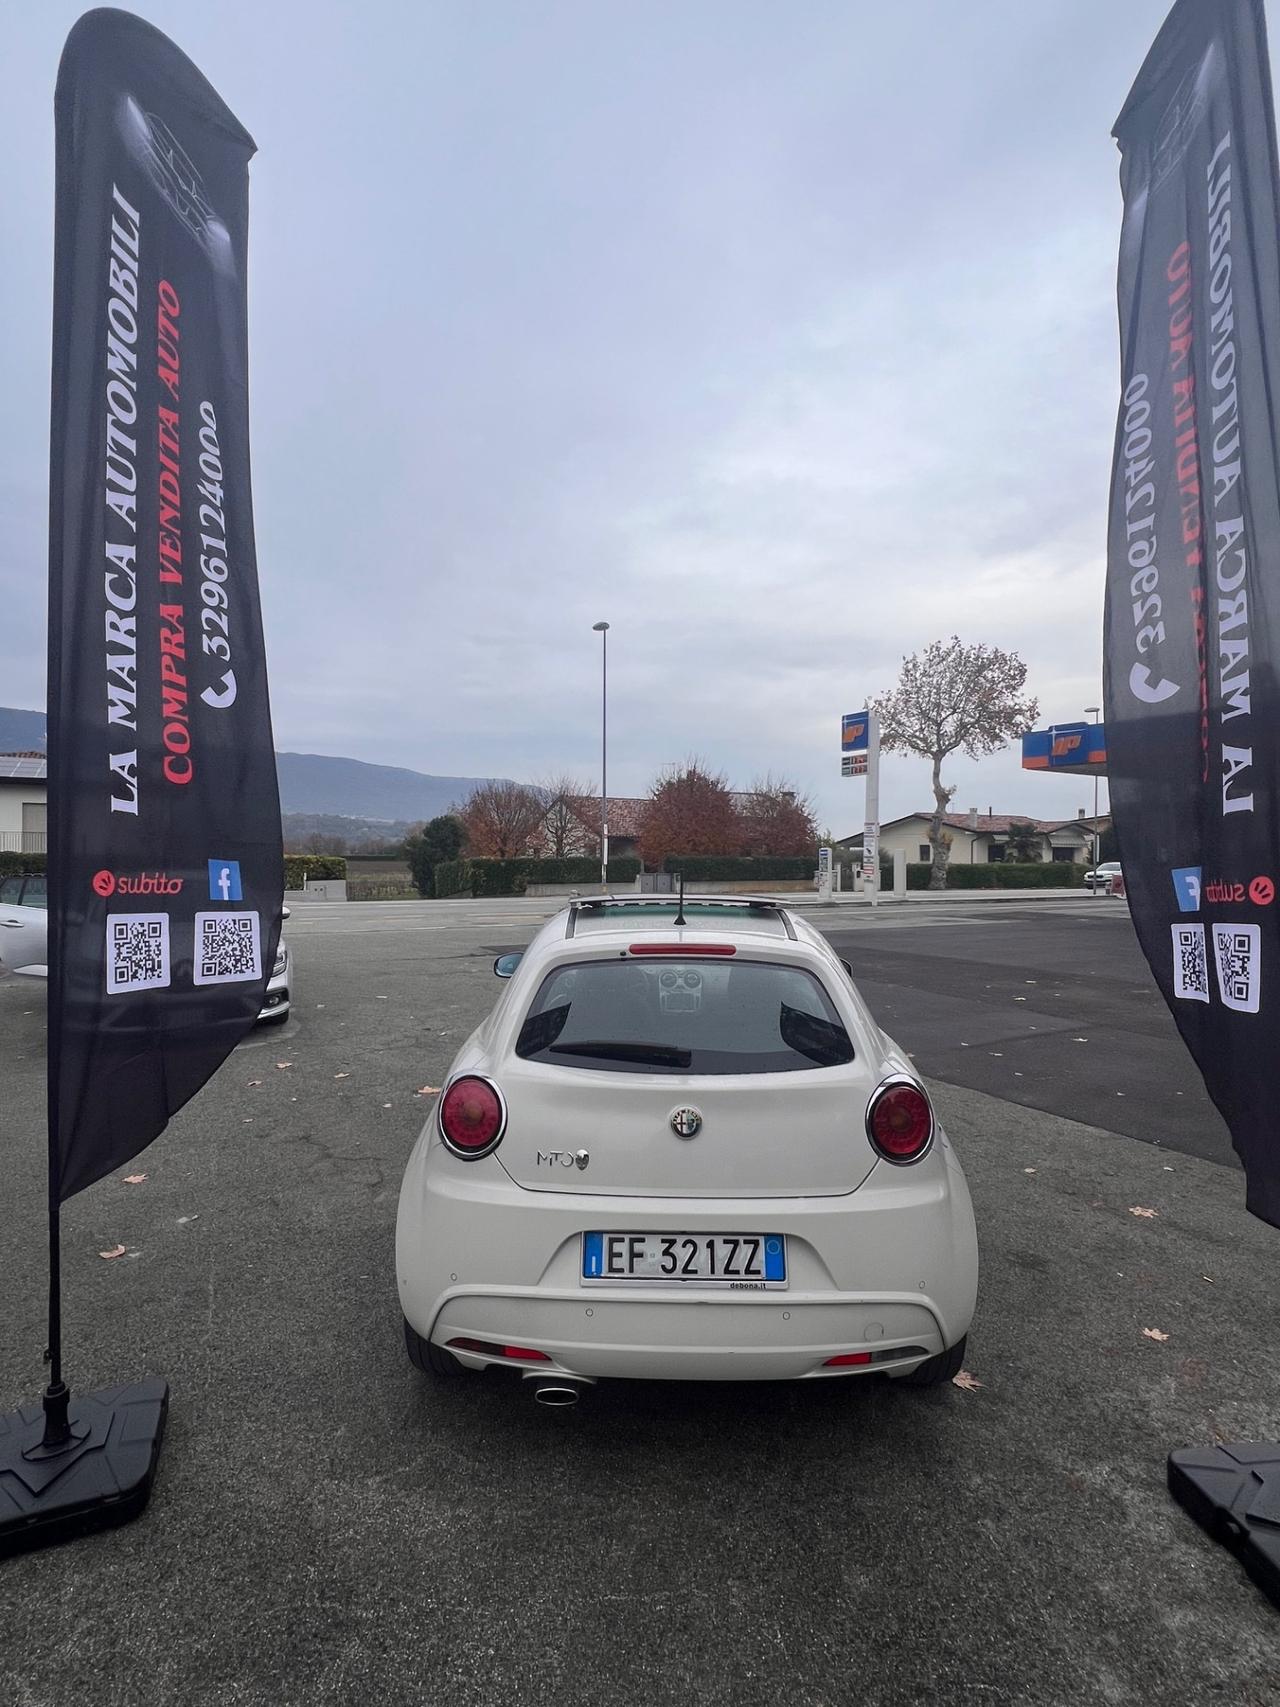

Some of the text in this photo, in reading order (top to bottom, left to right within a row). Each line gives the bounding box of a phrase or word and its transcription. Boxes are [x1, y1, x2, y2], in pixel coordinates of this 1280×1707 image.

[105, 182, 140, 816] LA MARCA AUTOMOBILI
[158, 280, 193, 785] COMPRA VENDITA AUTO
[197, 401, 230, 662] 3296124000
[117, 872, 184, 895] subito
[607, 1237, 761, 1275] EF 321ZZ
[730, 1281, 766, 1290] debona.it
